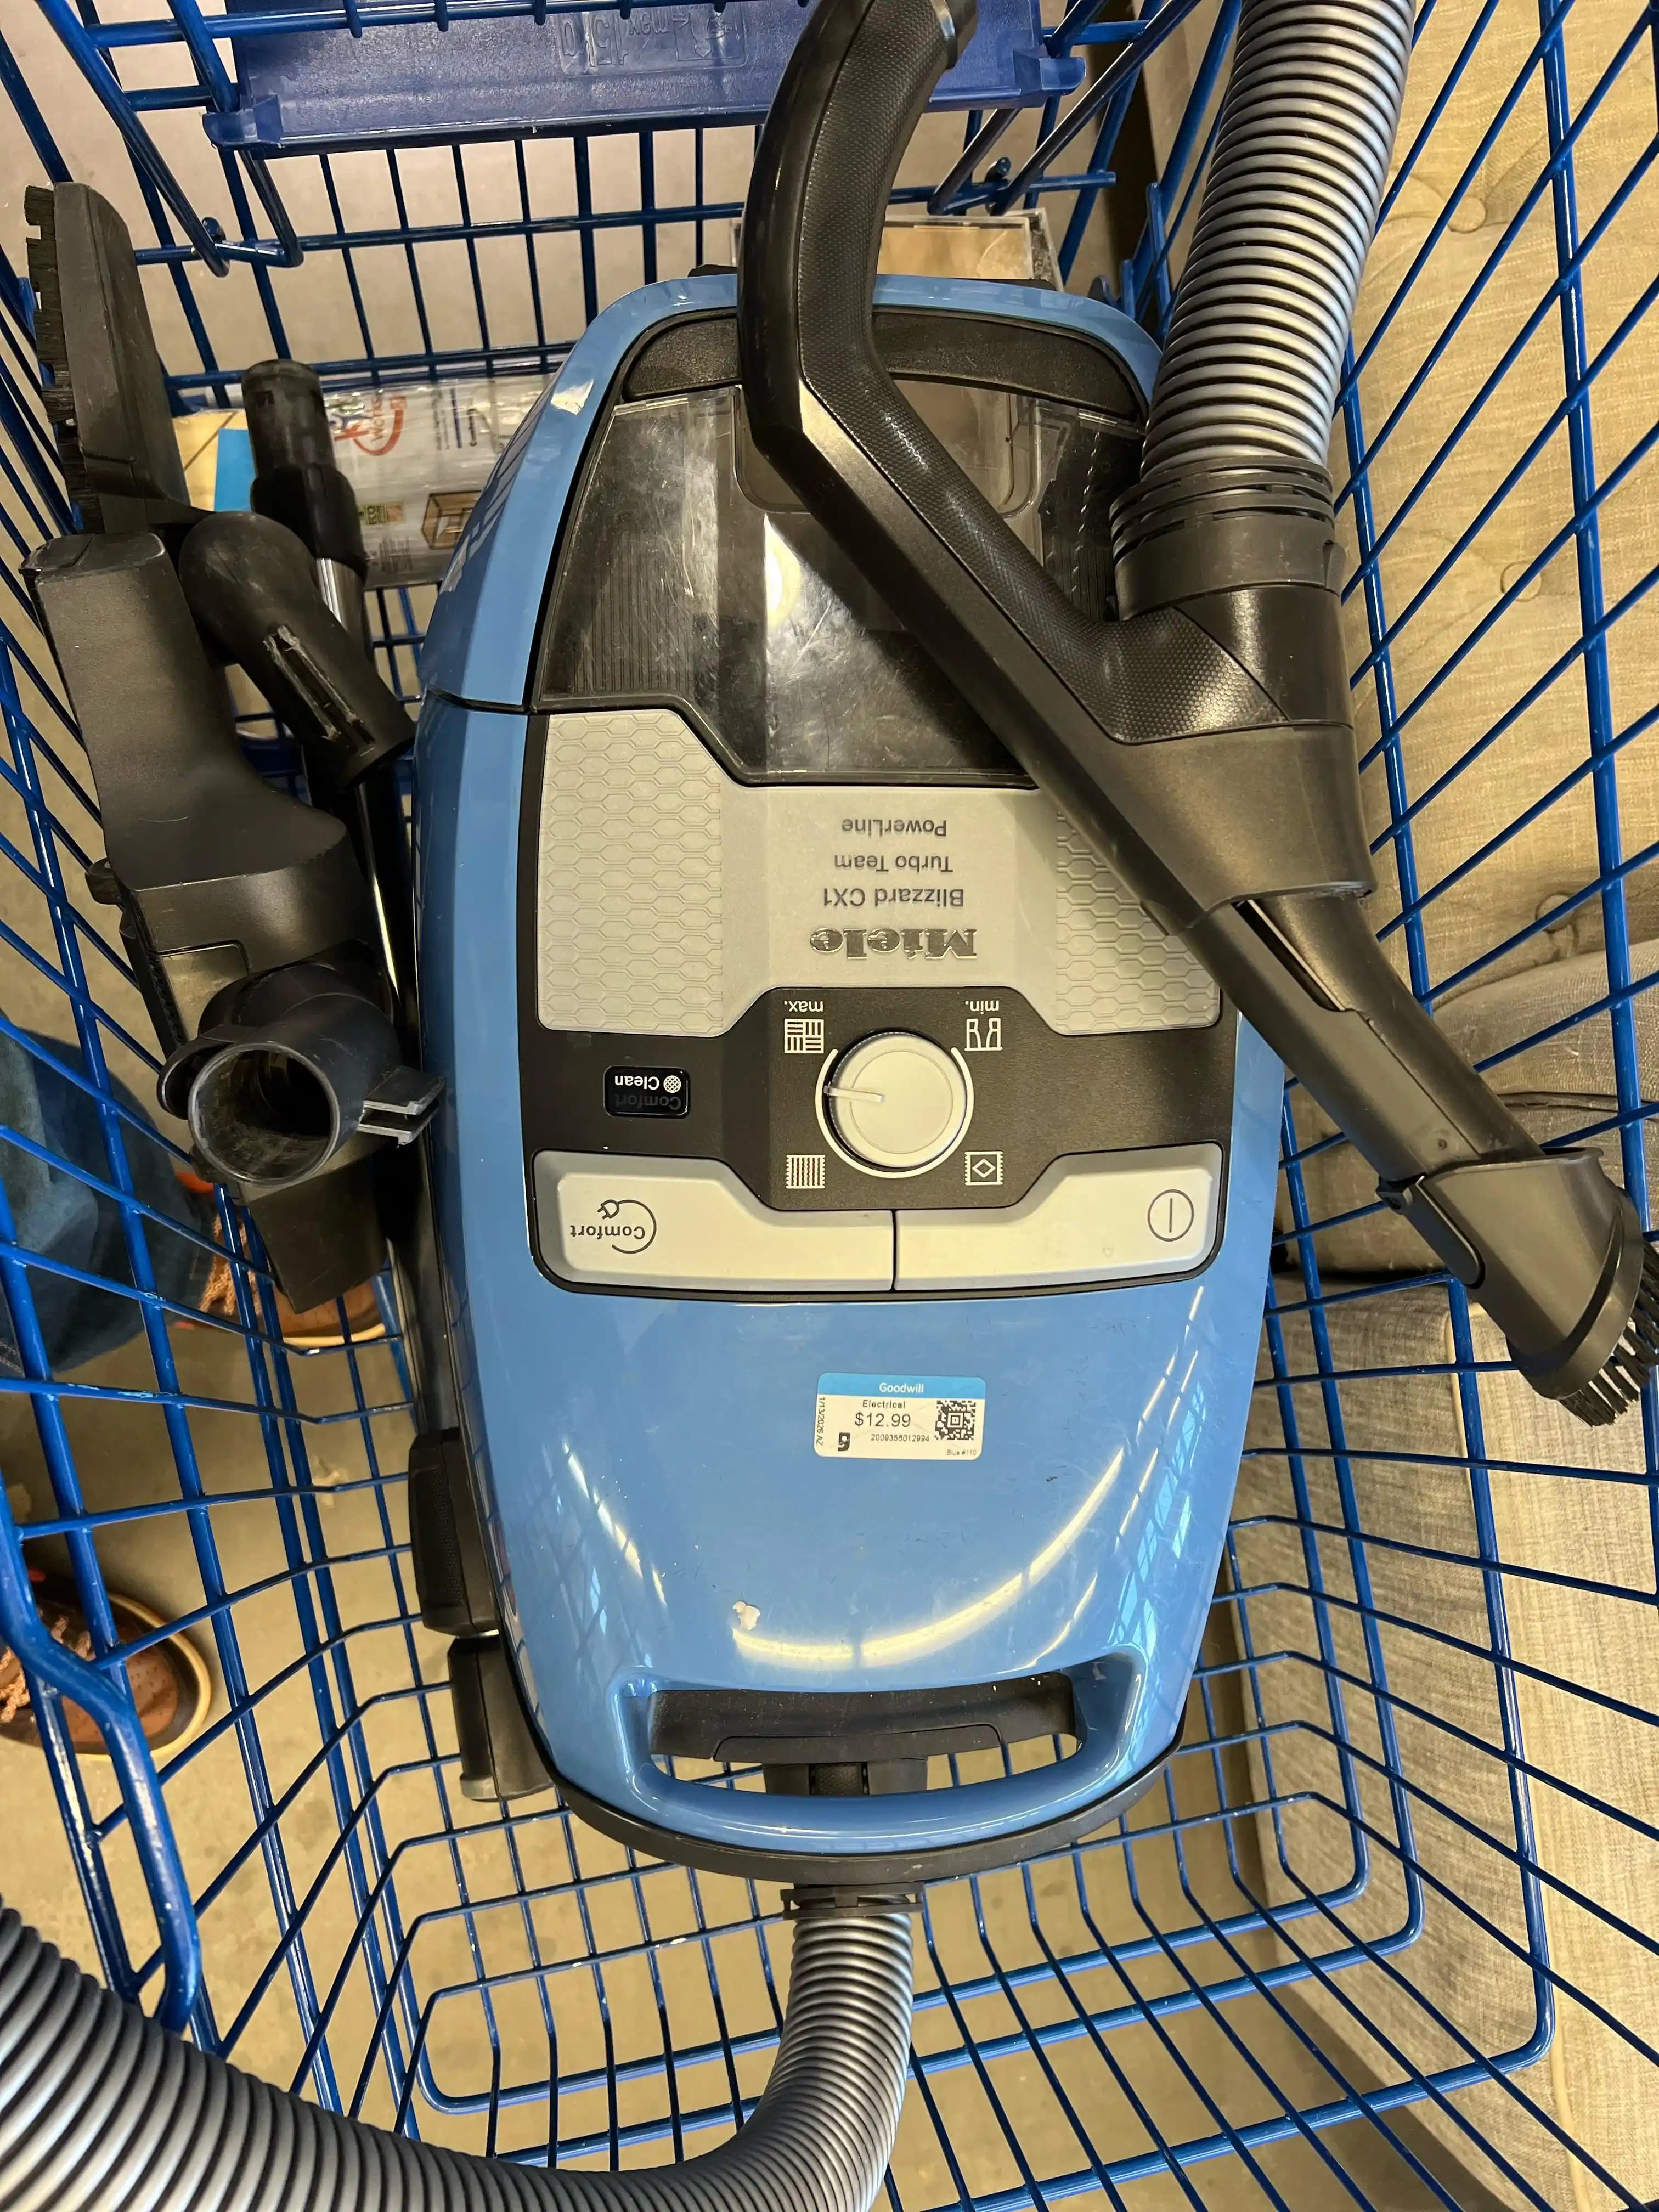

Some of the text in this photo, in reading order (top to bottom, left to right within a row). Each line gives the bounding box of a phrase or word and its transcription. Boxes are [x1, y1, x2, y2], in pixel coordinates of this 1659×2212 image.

[842, 818, 947, 837] PowerLine
[834, 854, 953, 872] Turbo Team
[823, 888, 964, 907] Blizzard CX1
[810, 927, 977, 960] Miele
[783, 1001, 824, 1013] max.
[964, 1001, 1000, 1014] min.
[614, 1075, 659, 1090] Clean
[614, 1093, 681, 1110] Comfort
[570, 1224, 645, 1240] Comfort
[879, 1382, 924, 1393] Goodwill
[862, 1400, 906, 1408] Electrical
[854, 1411, 911, 1428] $12.99
[871, 1434, 929, 1442] 2009356012994
